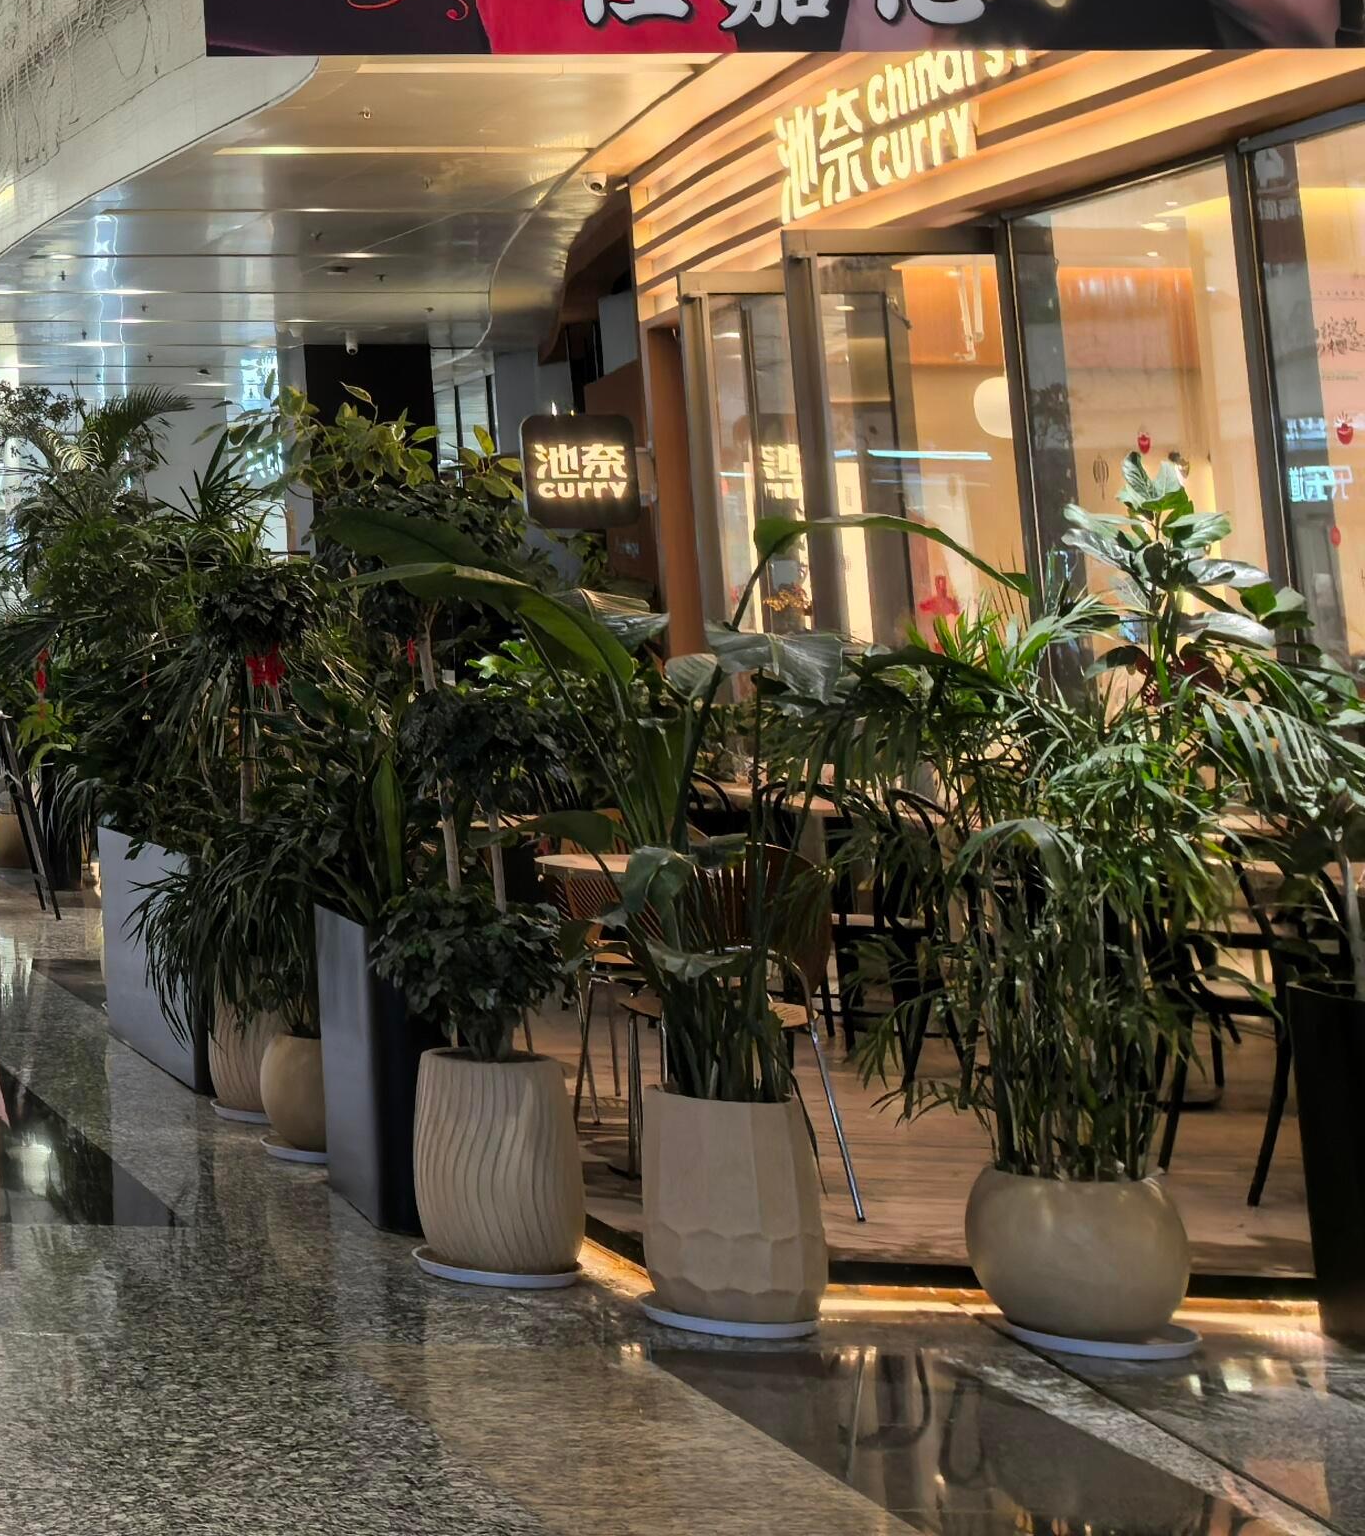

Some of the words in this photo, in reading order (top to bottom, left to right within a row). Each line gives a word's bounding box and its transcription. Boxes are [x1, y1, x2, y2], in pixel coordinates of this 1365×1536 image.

[775, 87, 869, 225] 池奈
[870, 102, 970, 186] curry
[534, 443, 628, 479] 池奈
[538, 481, 628, 499] curry
